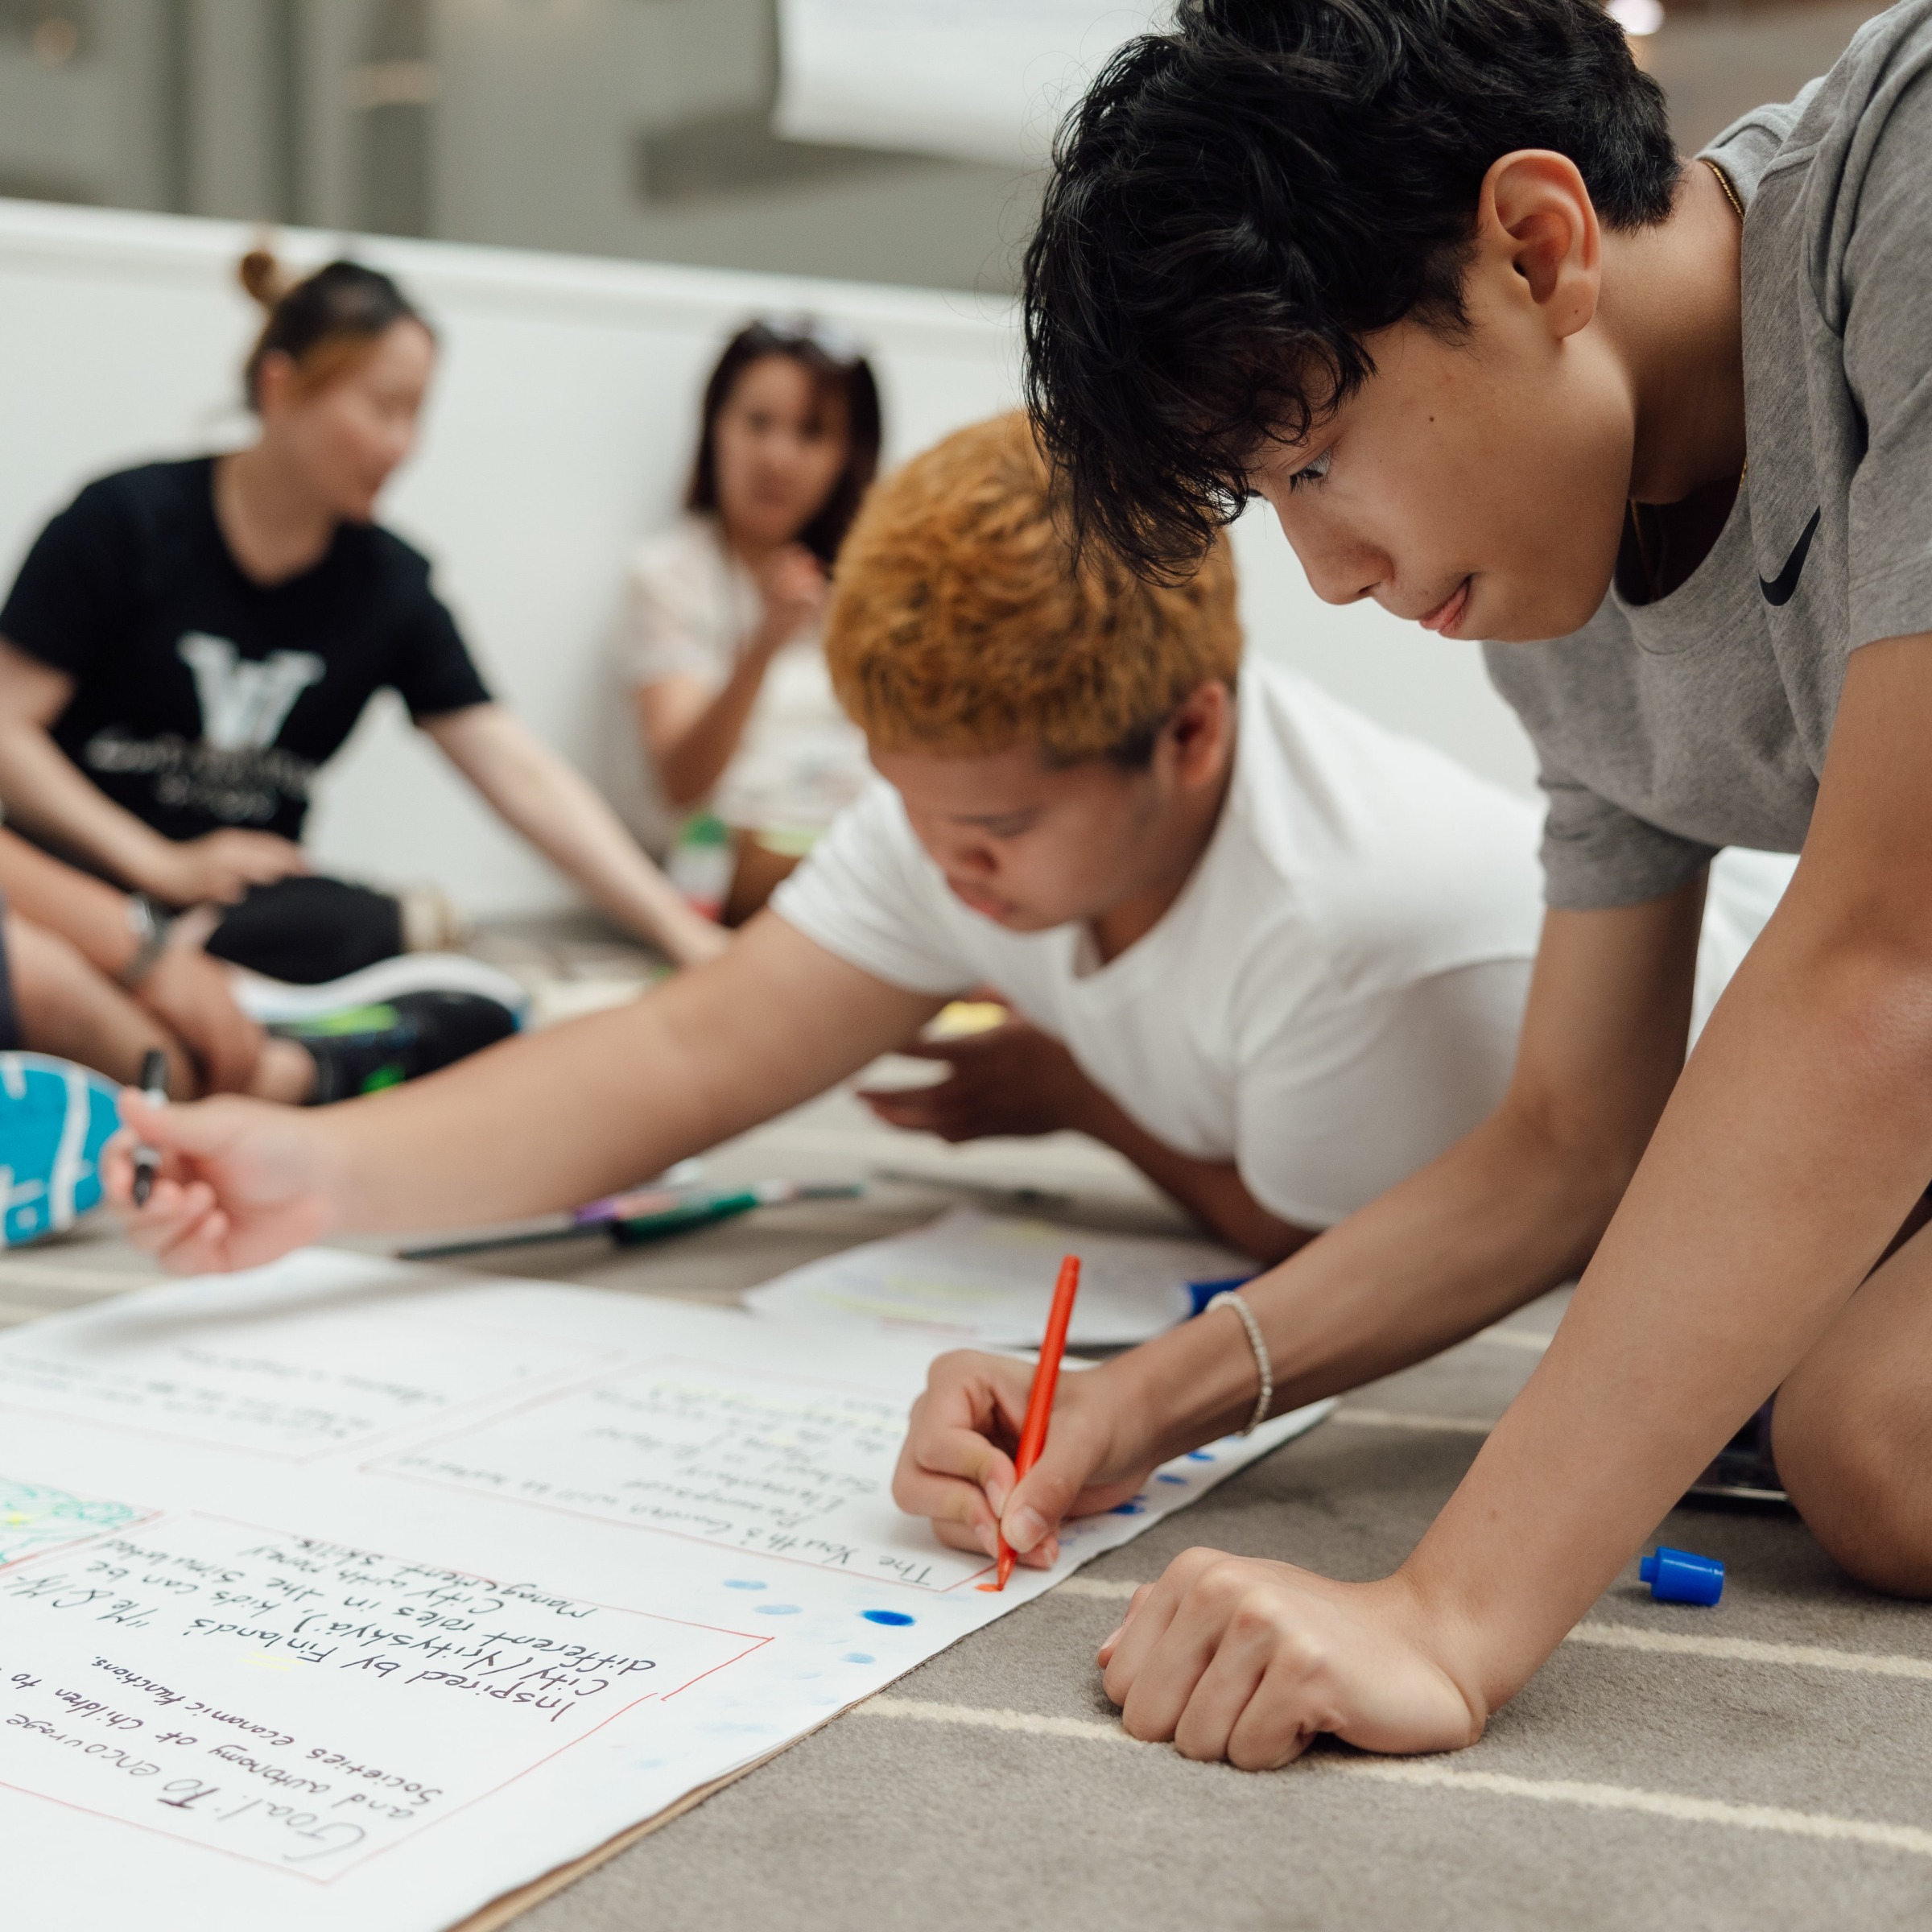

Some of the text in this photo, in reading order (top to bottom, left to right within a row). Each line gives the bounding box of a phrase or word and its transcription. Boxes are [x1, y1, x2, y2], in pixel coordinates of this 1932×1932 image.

[85, 1560, 130, 1584] be
[337, 1567, 407, 1590] with
[877, 1555, 932, 1587] The
[209, 1590, 282, 1618] kids
[265, 1577, 324, 1603] the
[402, 1585, 504, 1614] City
[342, 1596, 382, 1613] in
[391, 1606, 475, 1633] roles
[339, 1654, 402, 1678] by
[481, 1632, 656, 1675] different
[10, 1674, 43, 1690] to
[518, 1666, 609, 1696] City
[403, 1670, 576, 1723] Inspired
[155, 1732, 198, 1745] of
[184, 1702, 295, 1748] economic
[207, 1744, 331, 1795] autonomy
[305, 1747, 444, 1807] Societies
[6, 1714, 365, 1863] Goal: To encourage
[331, 1794, 415, 1821] and
